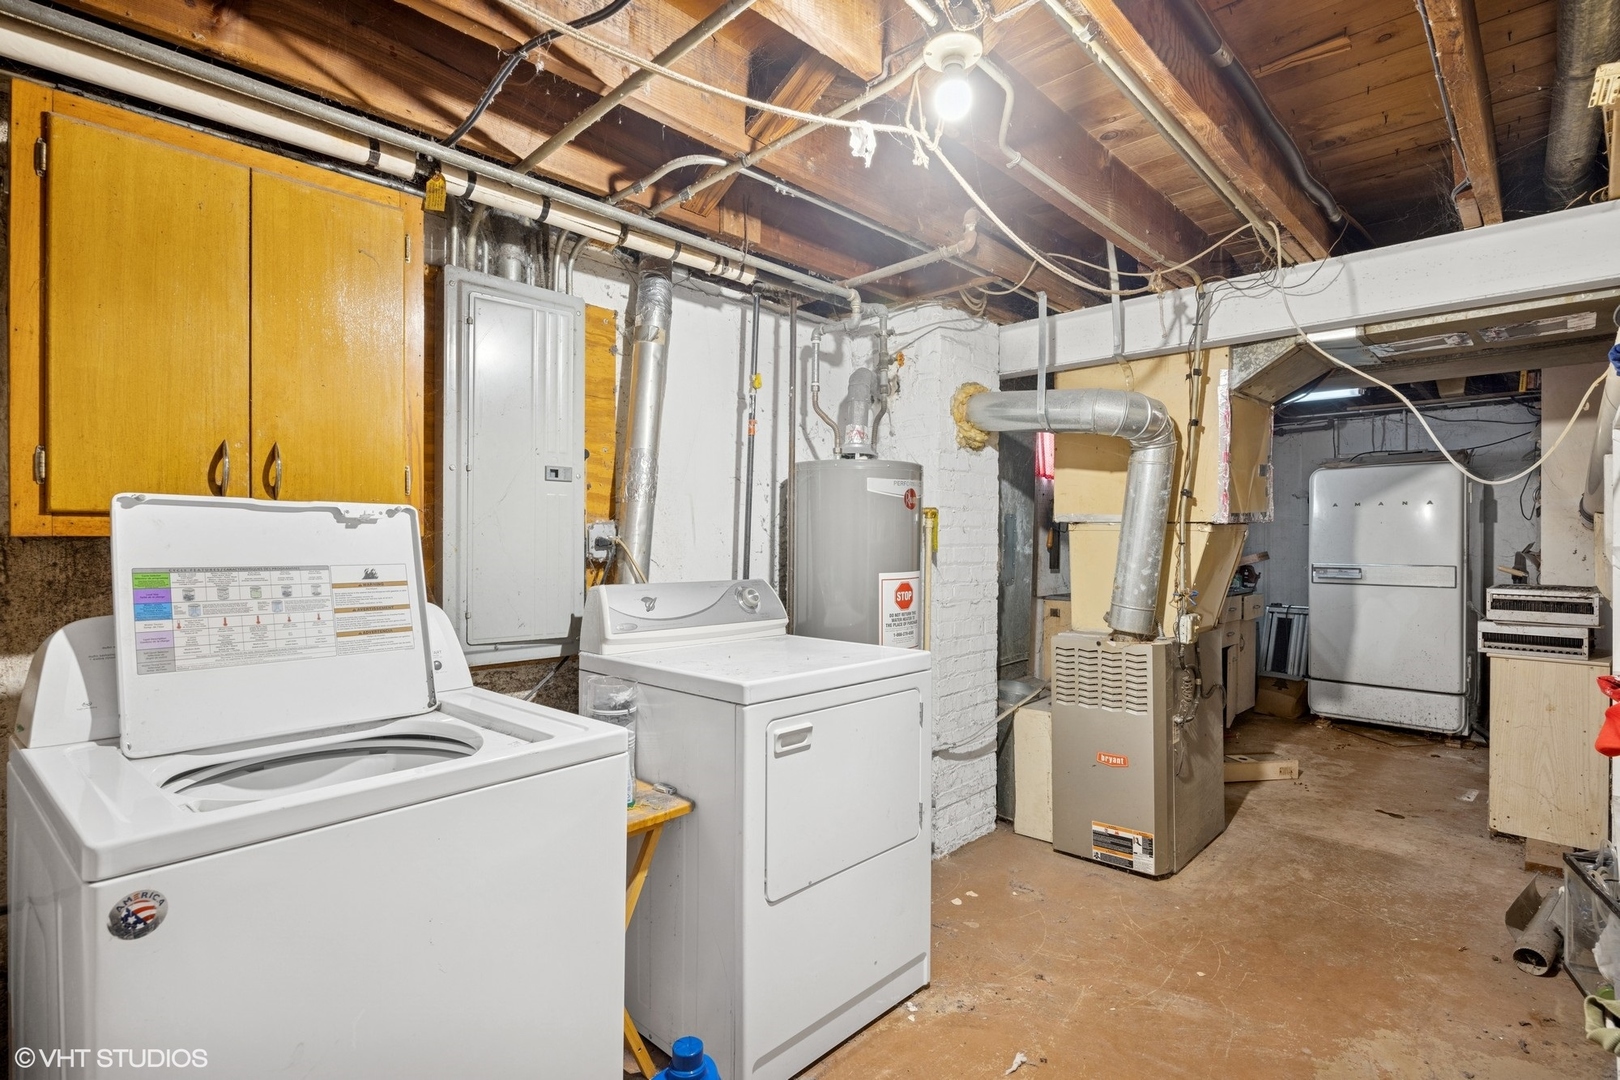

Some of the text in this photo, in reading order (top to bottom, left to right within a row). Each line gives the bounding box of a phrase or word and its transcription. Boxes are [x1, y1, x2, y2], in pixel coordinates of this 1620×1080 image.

[1332, 500, 1434, 508] AMANA
[896, 590, 912, 602] STOP
[1100, 754, 1124, 765] bryant
[116, 891, 165, 913] AMERICA
